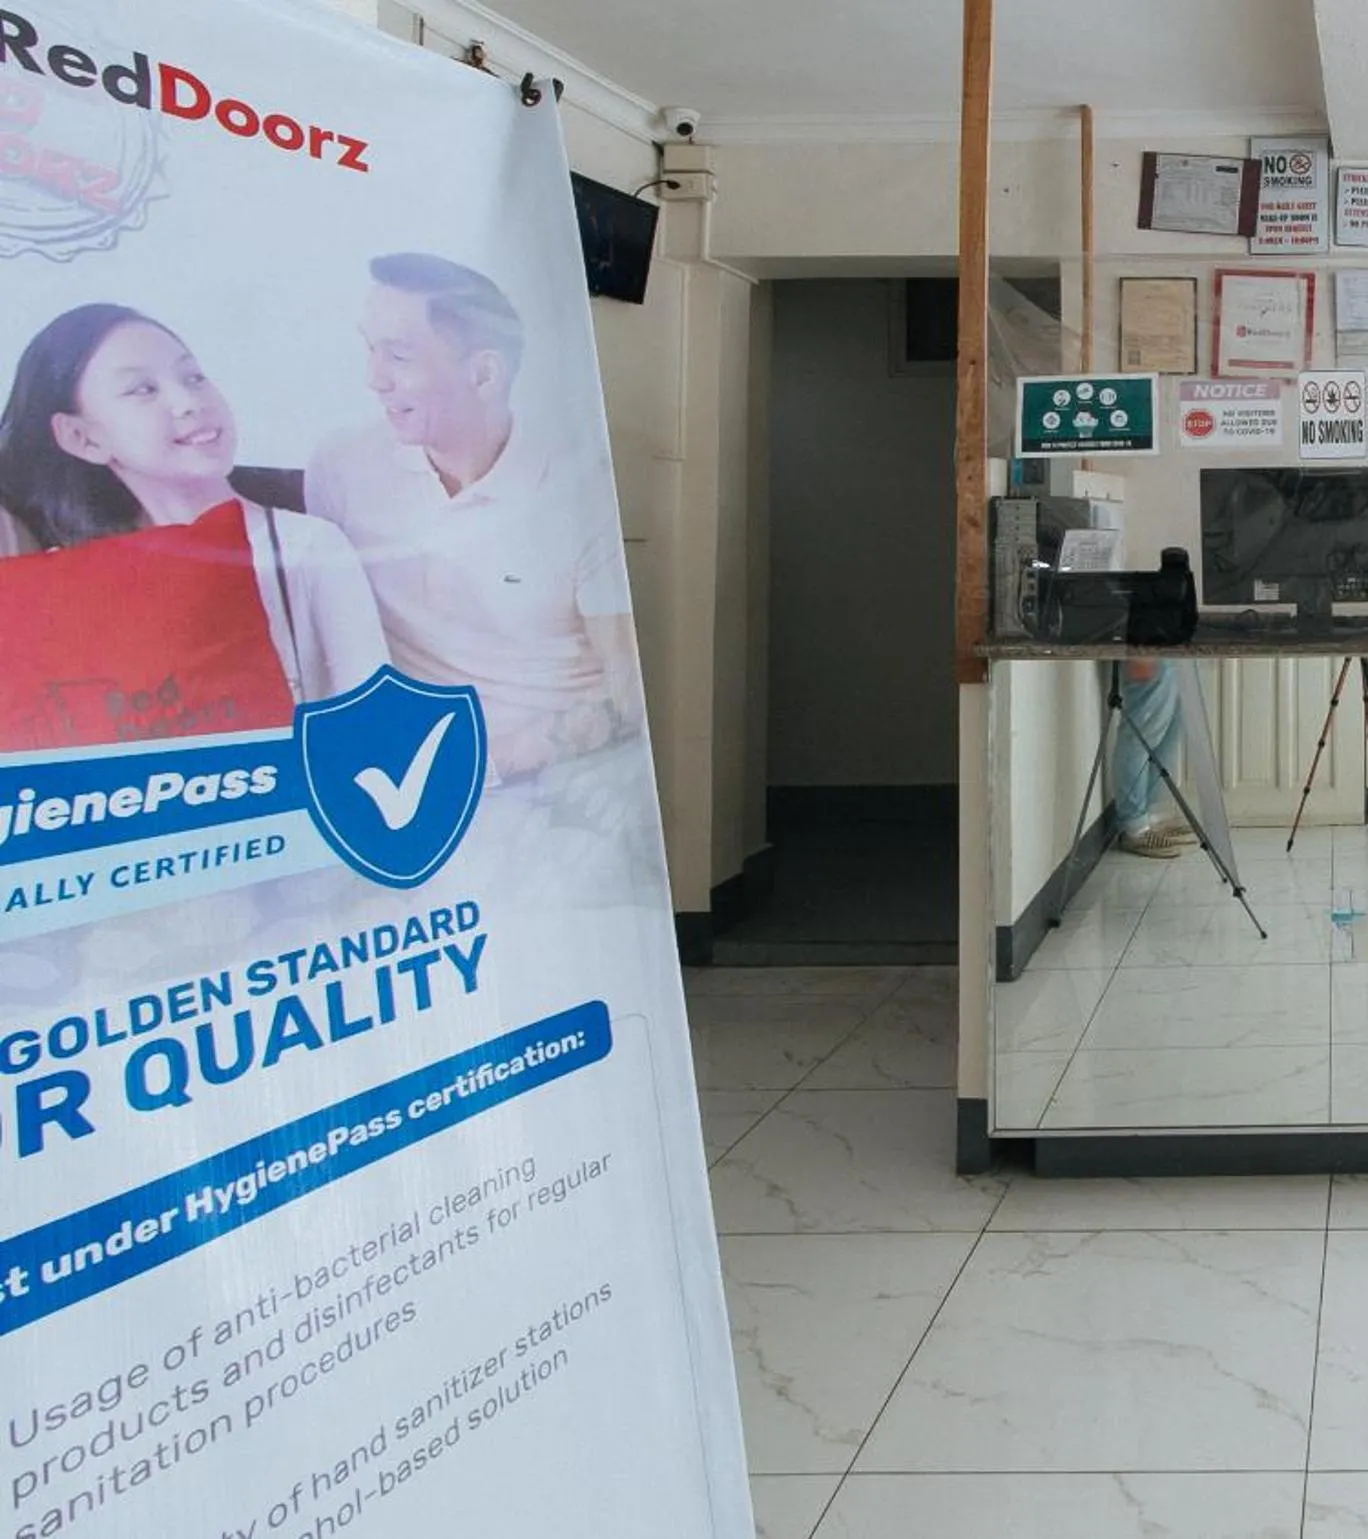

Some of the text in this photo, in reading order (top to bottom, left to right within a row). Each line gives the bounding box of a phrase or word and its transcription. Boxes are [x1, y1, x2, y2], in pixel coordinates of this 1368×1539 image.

[0, 9, 369, 173] RedDoorz
[1263, 155, 1287, 174] NO
[1263, 176, 1313, 188] SMOKING
[1193, 383, 1270, 399] NOTICE
[1221, 419, 1259, 427] ALLOWED
[1236, 428, 1276, 437] COVID-19
[1301, 419, 1364, 445] NO SMOKING
[5, 833, 287, 913] ALLY CERTIFIED
[0, 900, 481, 1075] GOLDEN STANDARD
[0, 933, 488, 1159] R QUALITY
[41, 1207, 180, 1284] under
[184, 1110, 402, 1222] HygienePass
[407, 1030, 586, 1121] certification:
[9, 1154, 536, 1449] Usage of anti-bacterial cleaning
[12, 1152, 613, 1509] products and disinfectants for regular
[245, 1300, 417, 1429] procedures
[268, 1482, 302, 1528] of
[311, 1424, 387, 1499] hand
[395, 1346, 508, 1439] sanitizer
[515, 1279, 613, 1355] stations
[299, 1346, 569, 1539] hol-based solution
